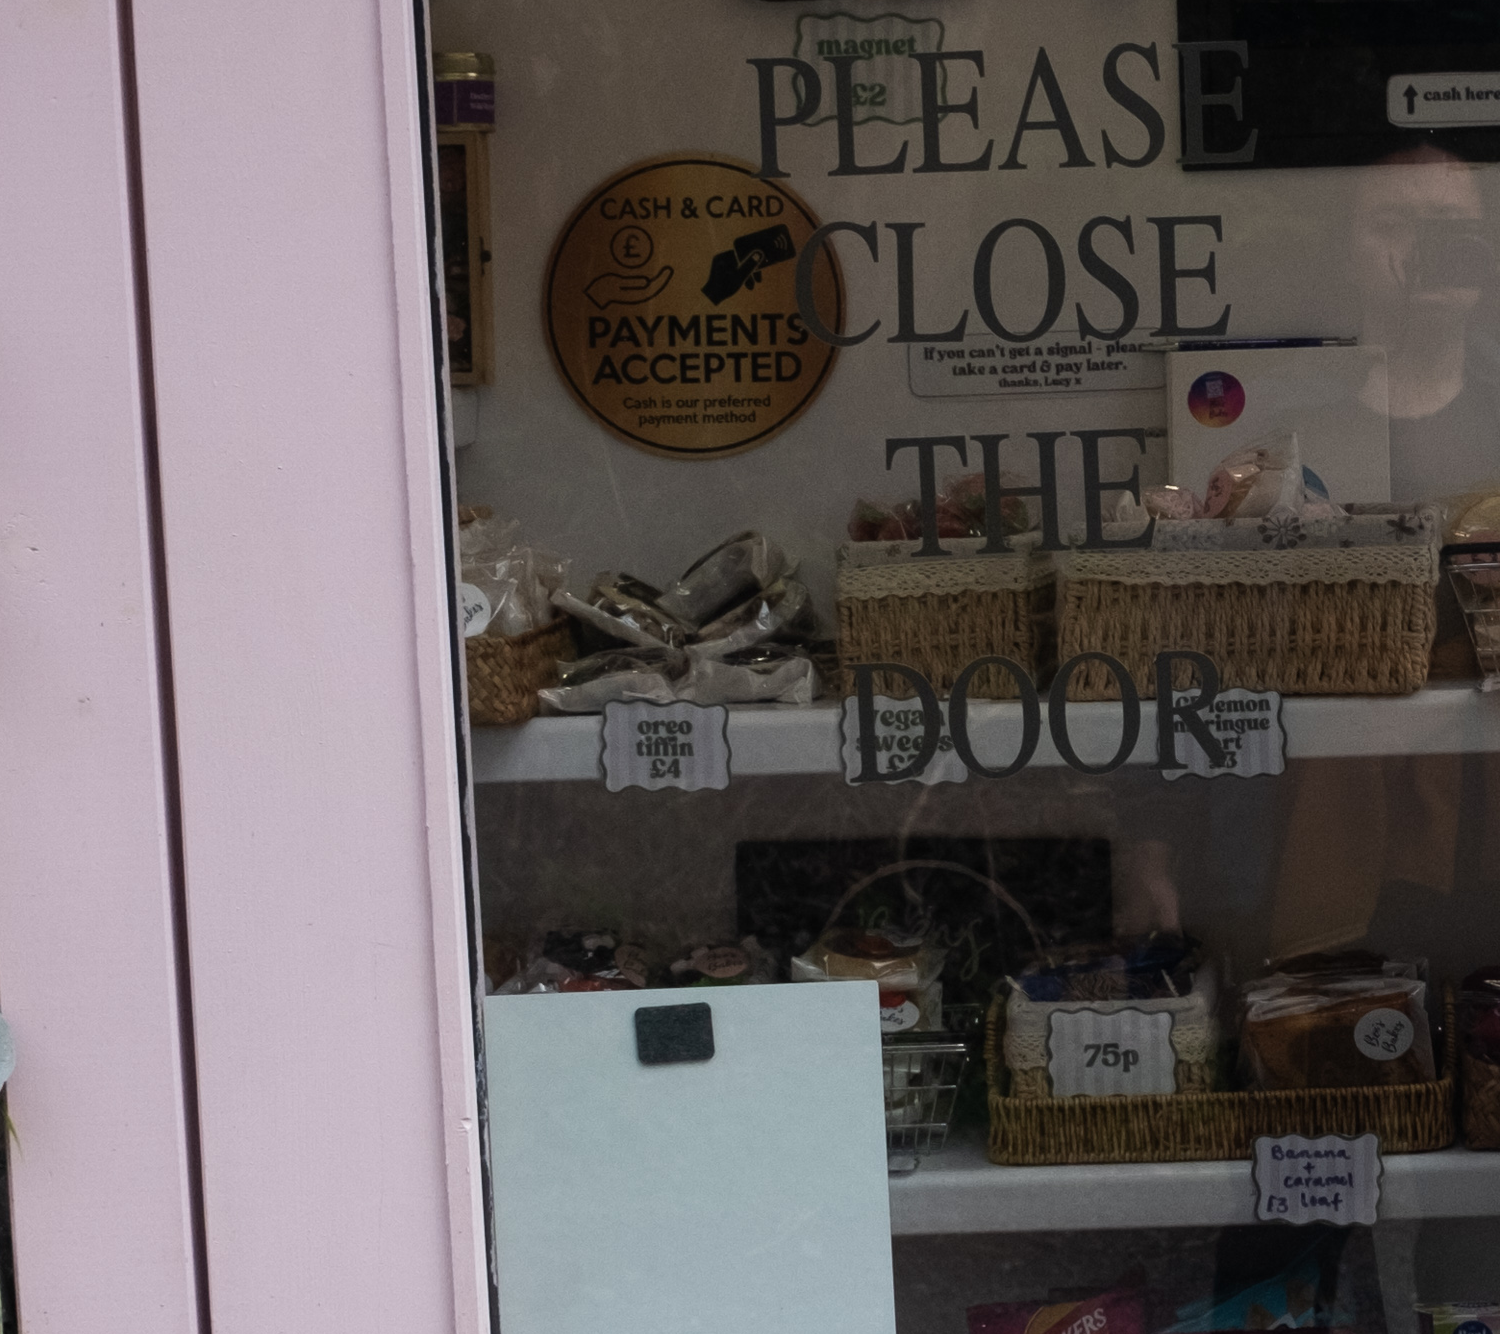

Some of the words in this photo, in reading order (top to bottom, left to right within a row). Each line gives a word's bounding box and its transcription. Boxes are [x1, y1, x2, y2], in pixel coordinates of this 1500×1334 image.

[816, 35, 917, 60] magnet
[1423, 86, 1462, 102] cash
[1466, 86, 1500, 101] here
[746, 39, 1258, 179] PLEASE
[600, 197, 671, 220] CASH
[680, 197, 699, 219] &
[705, 195, 784, 218] CARD
[795, 214, 1233, 347] CLOSE
[588, 313, 809, 348] PAYMENTS
[924, 347, 935, 360] If
[936, 347, 966, 363] you
[968, 344, 1006, 359] can't
[1008, 344, 1031, 360] get
[1033, 346, 1043, 356] a
[1046, 341, 1093, 359] signal
[592, 350, 802, 385] ACCEPTED
[952, 362, 985, 376] take
[988, 365, 998, 374] a
[1001, 360, 1037, 374] card
[1039, 360, 1052, 373] &
[1055, 362, 1083, 376] pay
[1086, 358, 1128, 372] later.
[998, 377, 1043, 389] thanks,
[1044, 376, 1071, 389] Lucy
[1073, 377, 1082, 386] x
[623, 396, 657, 410] Cash
[661, 396, 672, 409] is
[675, 398, 700, 409] our
[702, 394, 771, 411] preferred
[638, 413, 699, 428] payment
[702, 410, 756, 424] method
[885, 426, 1157, 558] THE
[637, 720, 693, 735] oreo
[846, 650, 1227, 784] DOOR
[1172, 714, 1271, 734] mringue
[635, 735, 695, 757] tiffin
[650, 758, 681, 779] £4
[1084, 1042, 1139, 1073] 75p
[1271, 1144, 1352, 1162] Banana
[1303, 1162, 1315, 1174] +
[1283, 1172, 1354, 1188] caramel
